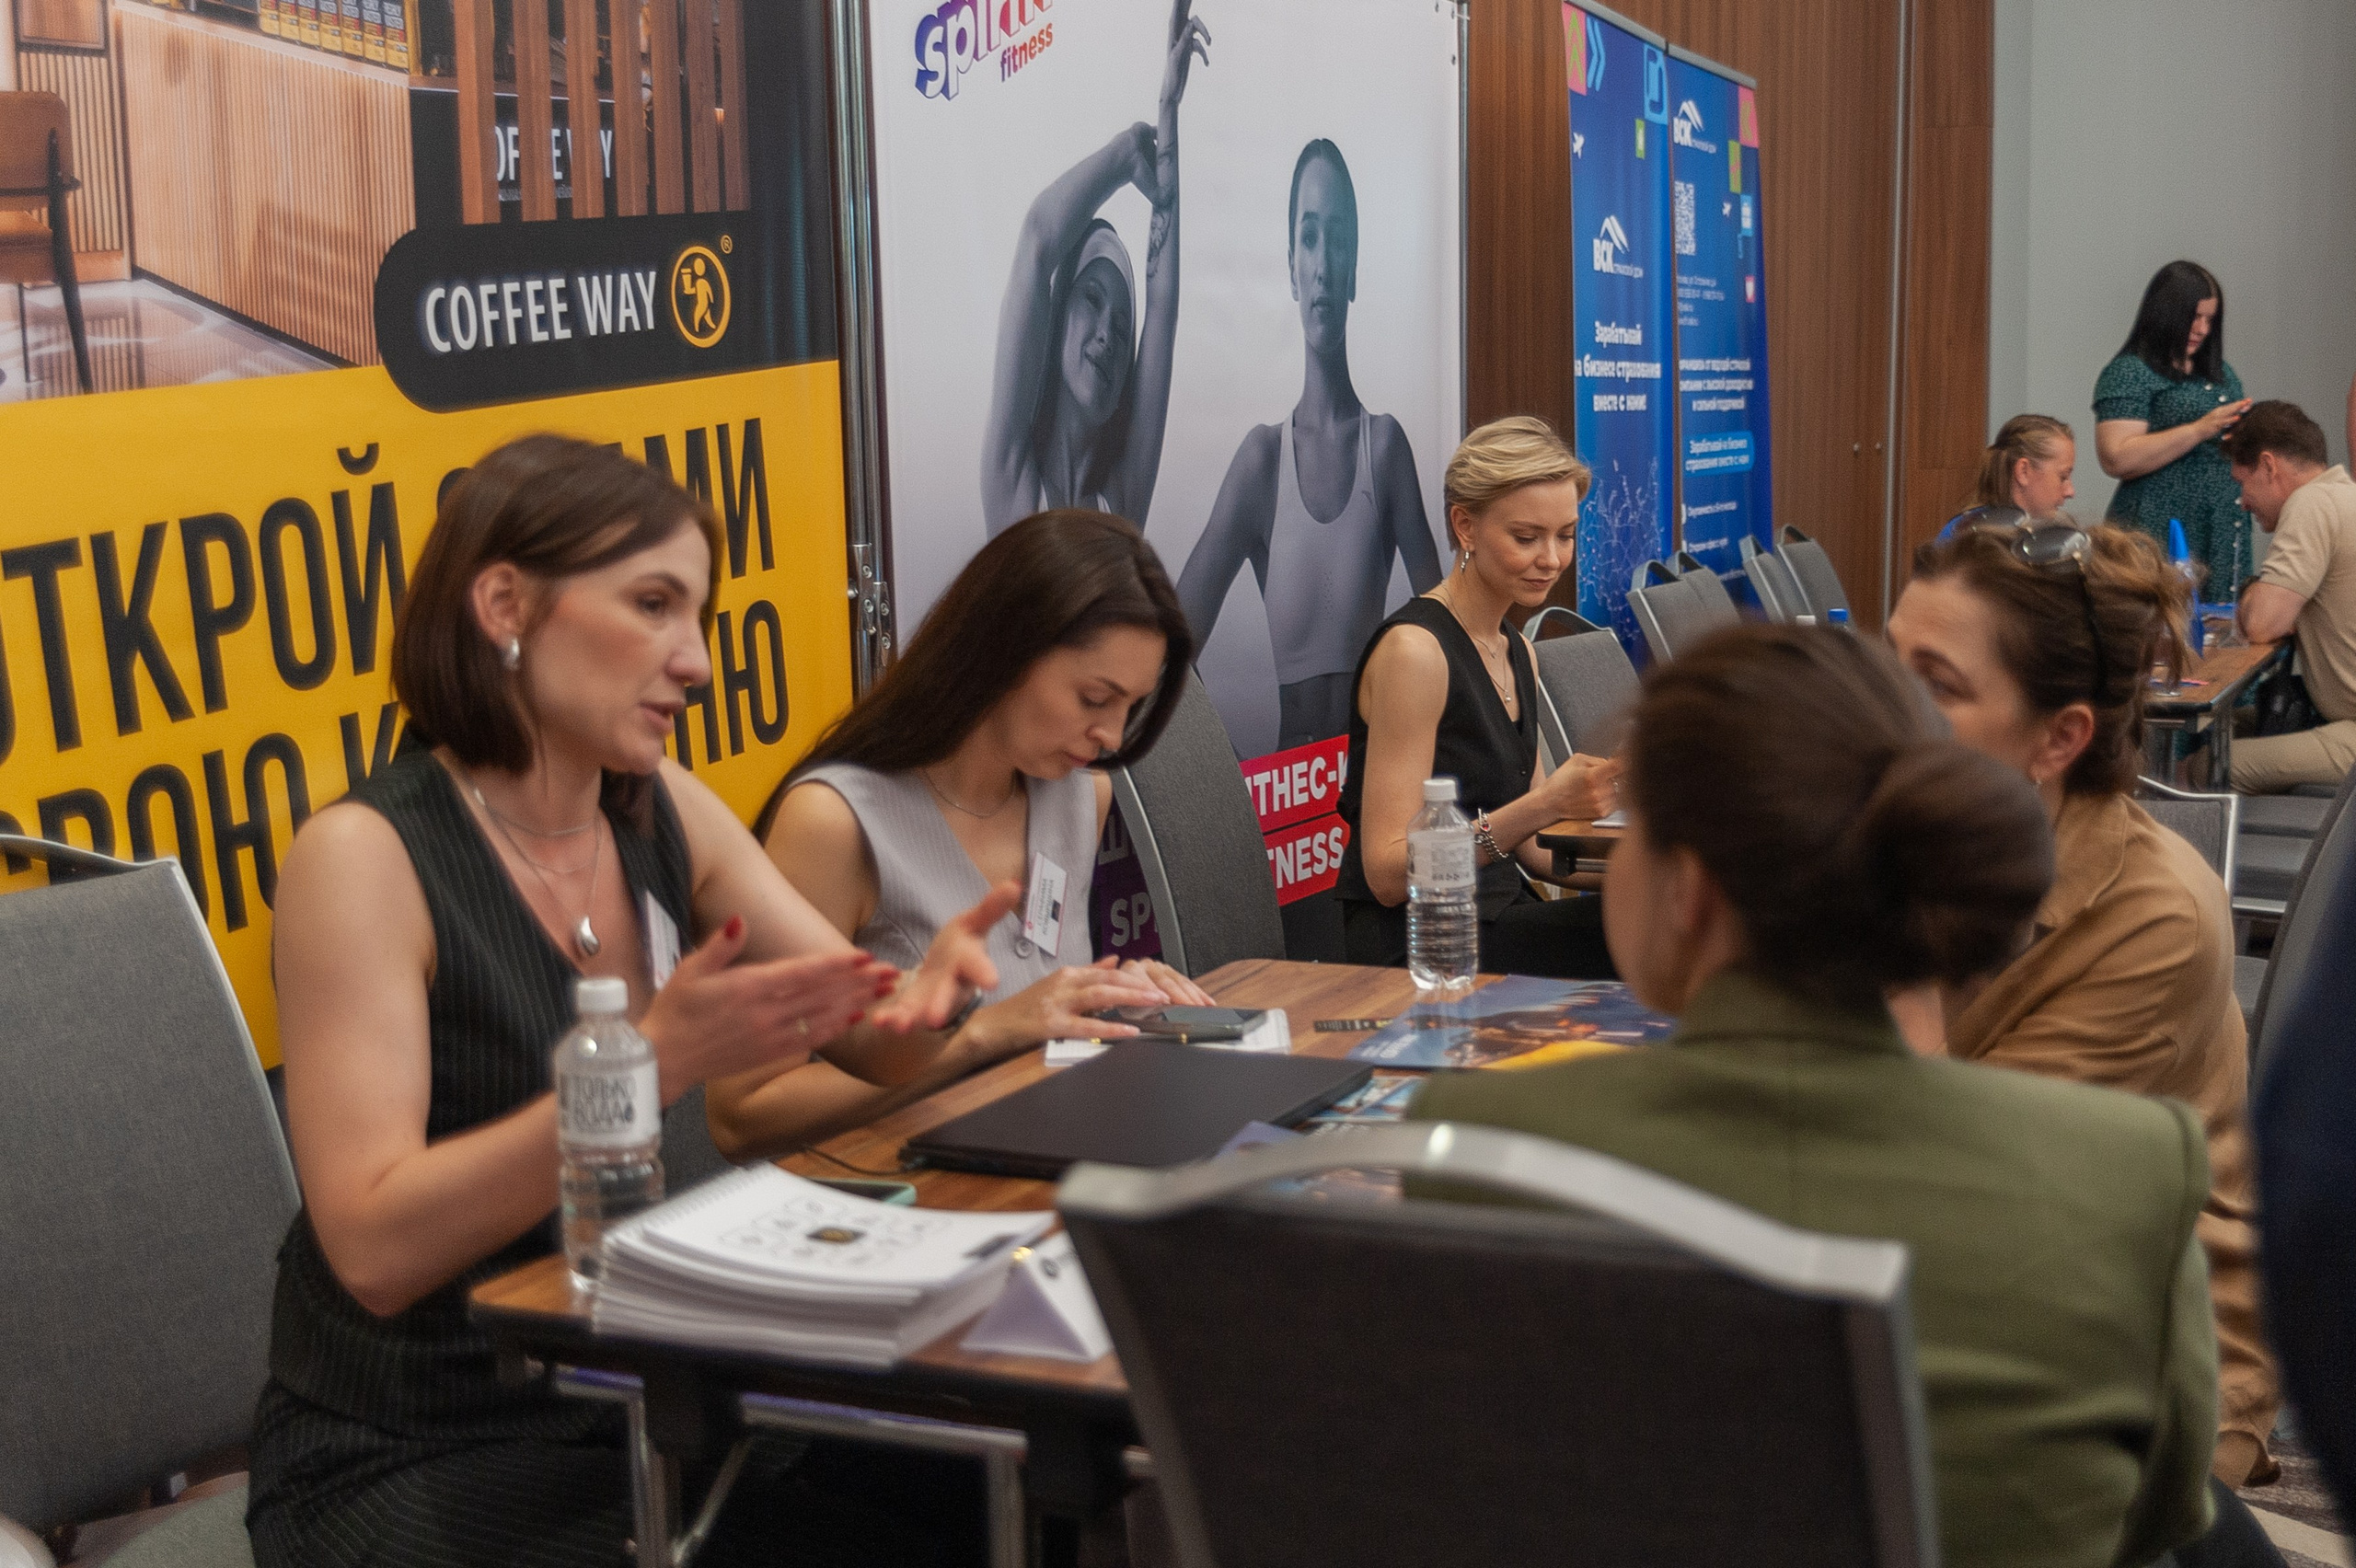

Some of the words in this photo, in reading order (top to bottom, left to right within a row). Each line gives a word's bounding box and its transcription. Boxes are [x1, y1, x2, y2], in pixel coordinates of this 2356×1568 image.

[1000, 22, 1054, 83] fitness
[426, 279, 572, 352] COFFEE
[578, 271, 656, 336] WAY
[0, 444, 407, 768] ТКРОЙ
[1266, 826, 1345, 889] NESS
